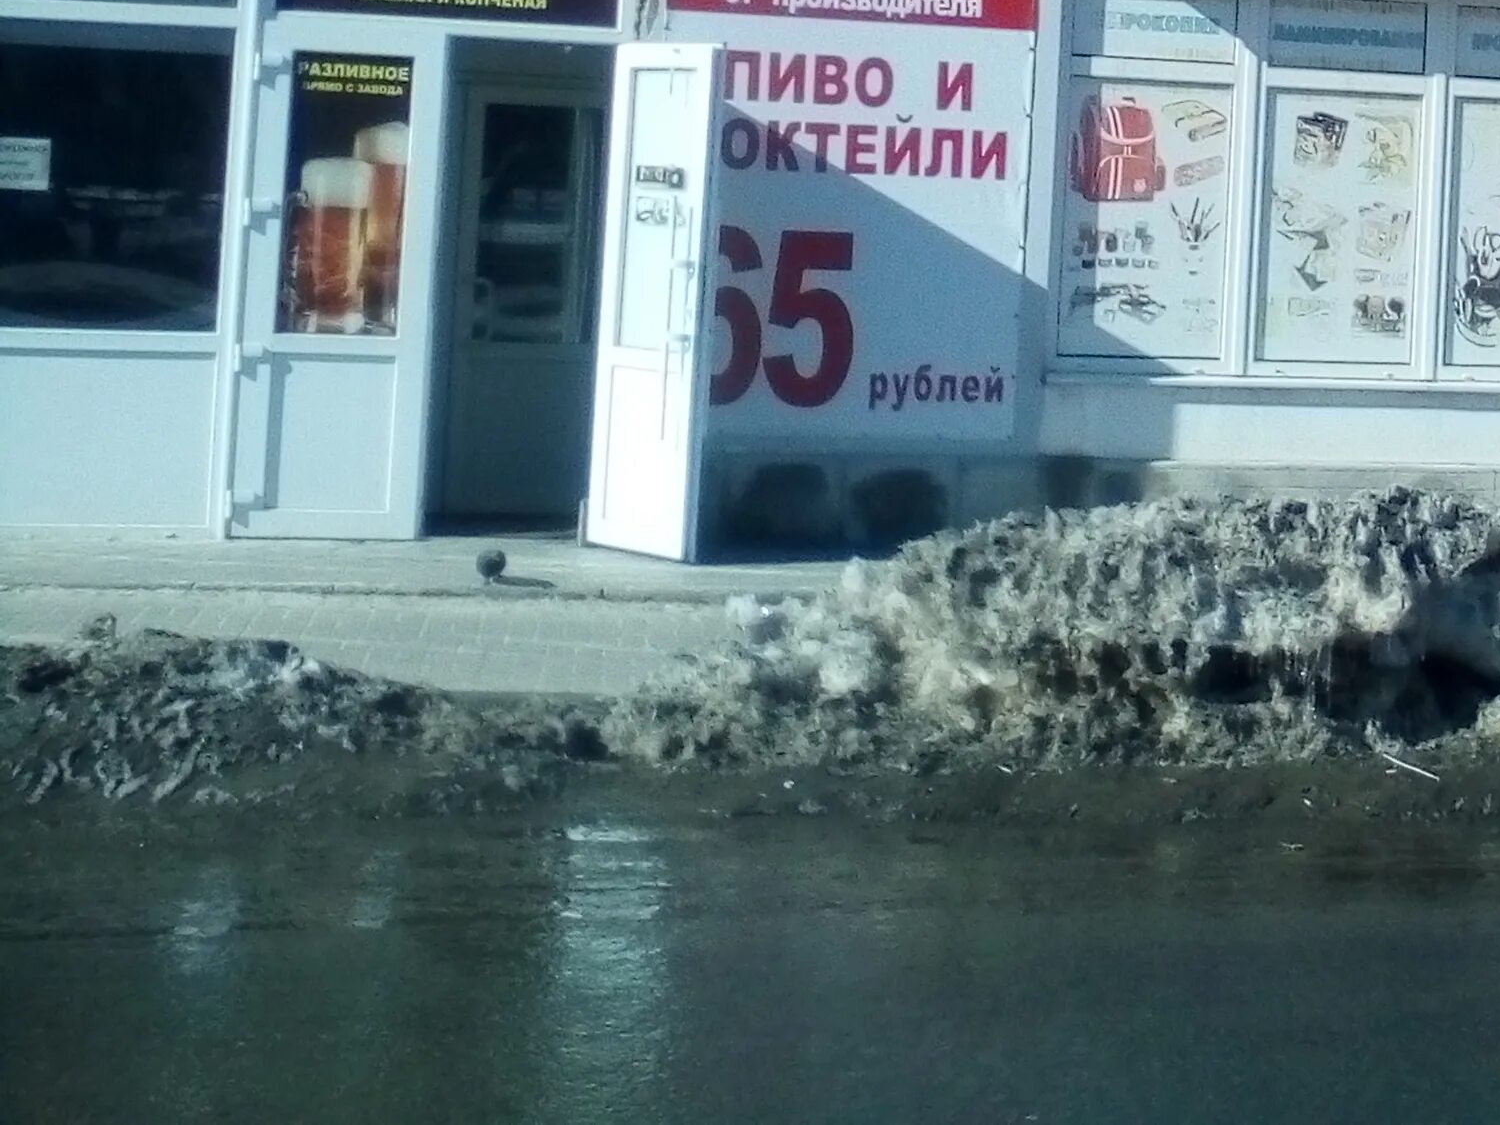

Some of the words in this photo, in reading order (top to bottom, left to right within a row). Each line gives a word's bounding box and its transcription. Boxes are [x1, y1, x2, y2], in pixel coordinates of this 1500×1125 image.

[298, 61, 410, 82] РАЗЛИВНОЕ
[723, 49, 893, 107] ПИВО
[935, 60, 974, 112] И
[720, 113, 1008, 181] ОКТЕЙЛИ
[867, 363, 1005, 412] рублей
